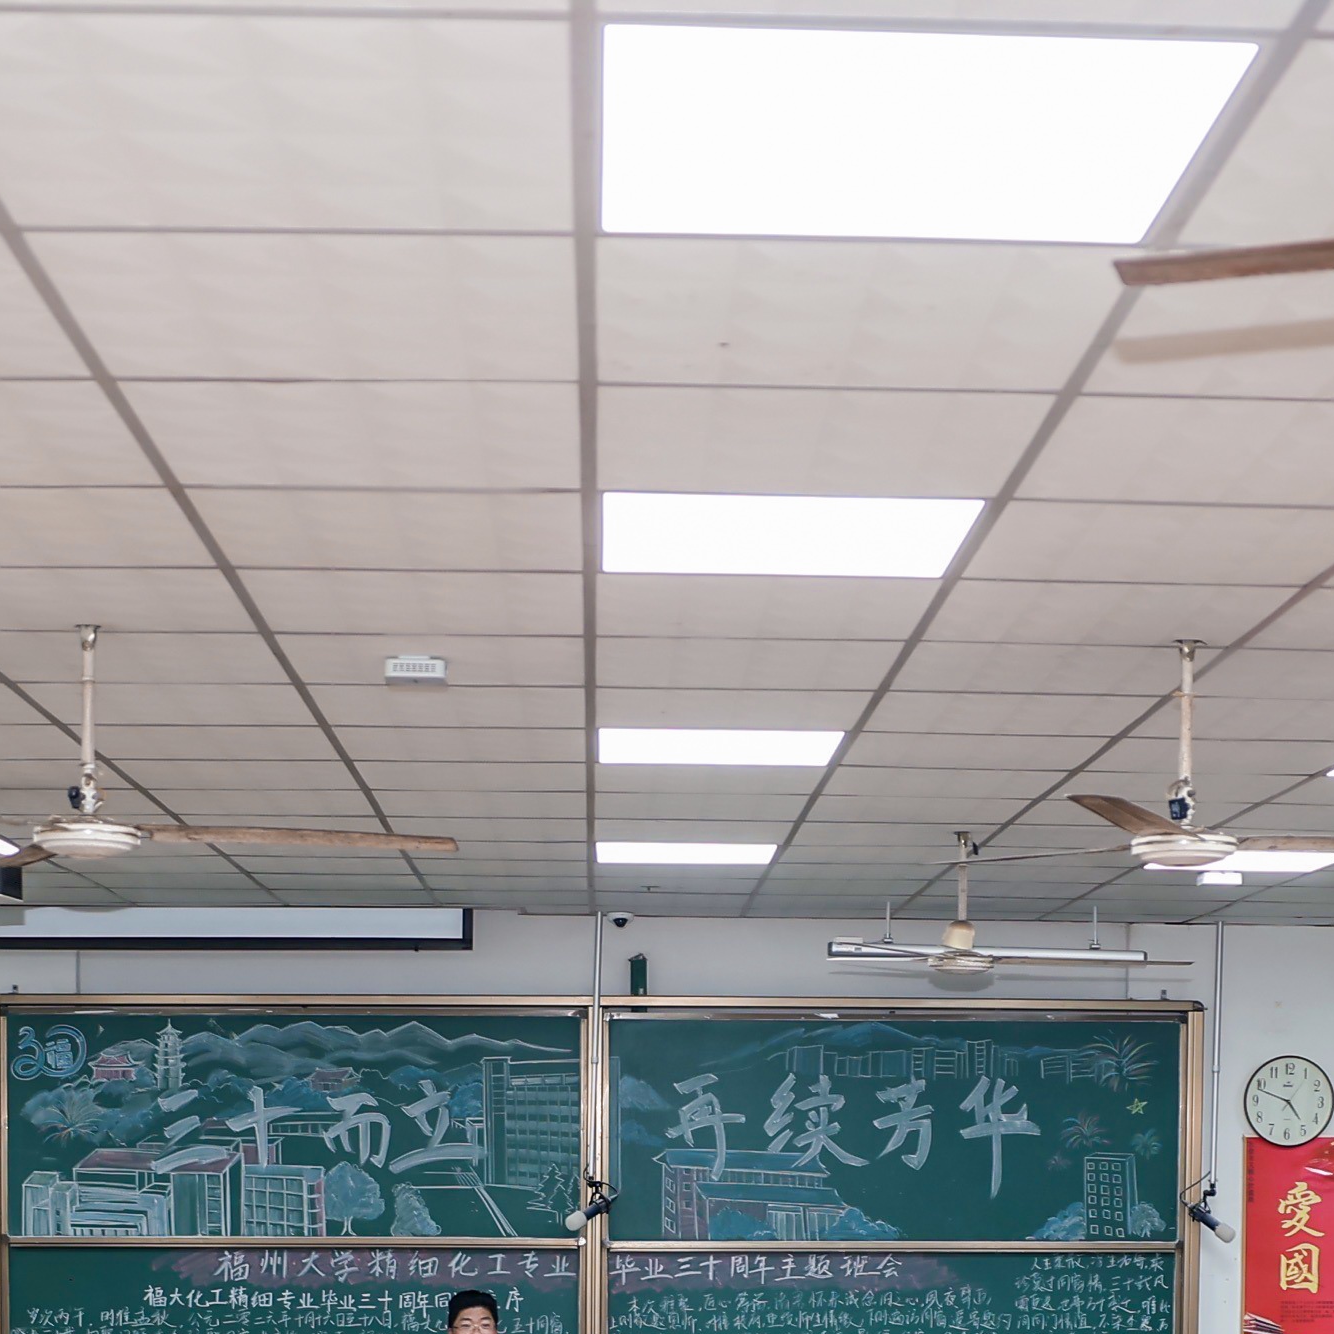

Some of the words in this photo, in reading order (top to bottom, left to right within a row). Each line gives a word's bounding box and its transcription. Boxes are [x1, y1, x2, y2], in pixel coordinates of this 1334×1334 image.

[1270, 1067, 1278, 1078] 11
[1285, 1062, 1295, 1075] 12
[1303, 1067, 1308, 1079] 1
[1257, 1078, 1266, 1089] 10
[1313, 1080, 1320, 1092] 2
[1252, 1095, 1259, 1106] 9
[1317, 1097, 1324, 1108] 3
[1256, 1111, 1263, 1123] 8
[1312, 1113, 1318, 1125] 4
[151, 1080, 489, 1174] 三十而立
[665, 1070, 1042, 1199] 再续芳华
[1268, 1123, 1275, 1135] 7
[1284, 1128, 1290, 1140] 6
[1300, 1125, 1306, 1136] 5
[1277, 1181, 1325, 1294] 愛國
[214, 1249, 578, 1283] 福州大学精细化工专业
[609, 1253, 903, 1285] 毕业三十周年主题班会
